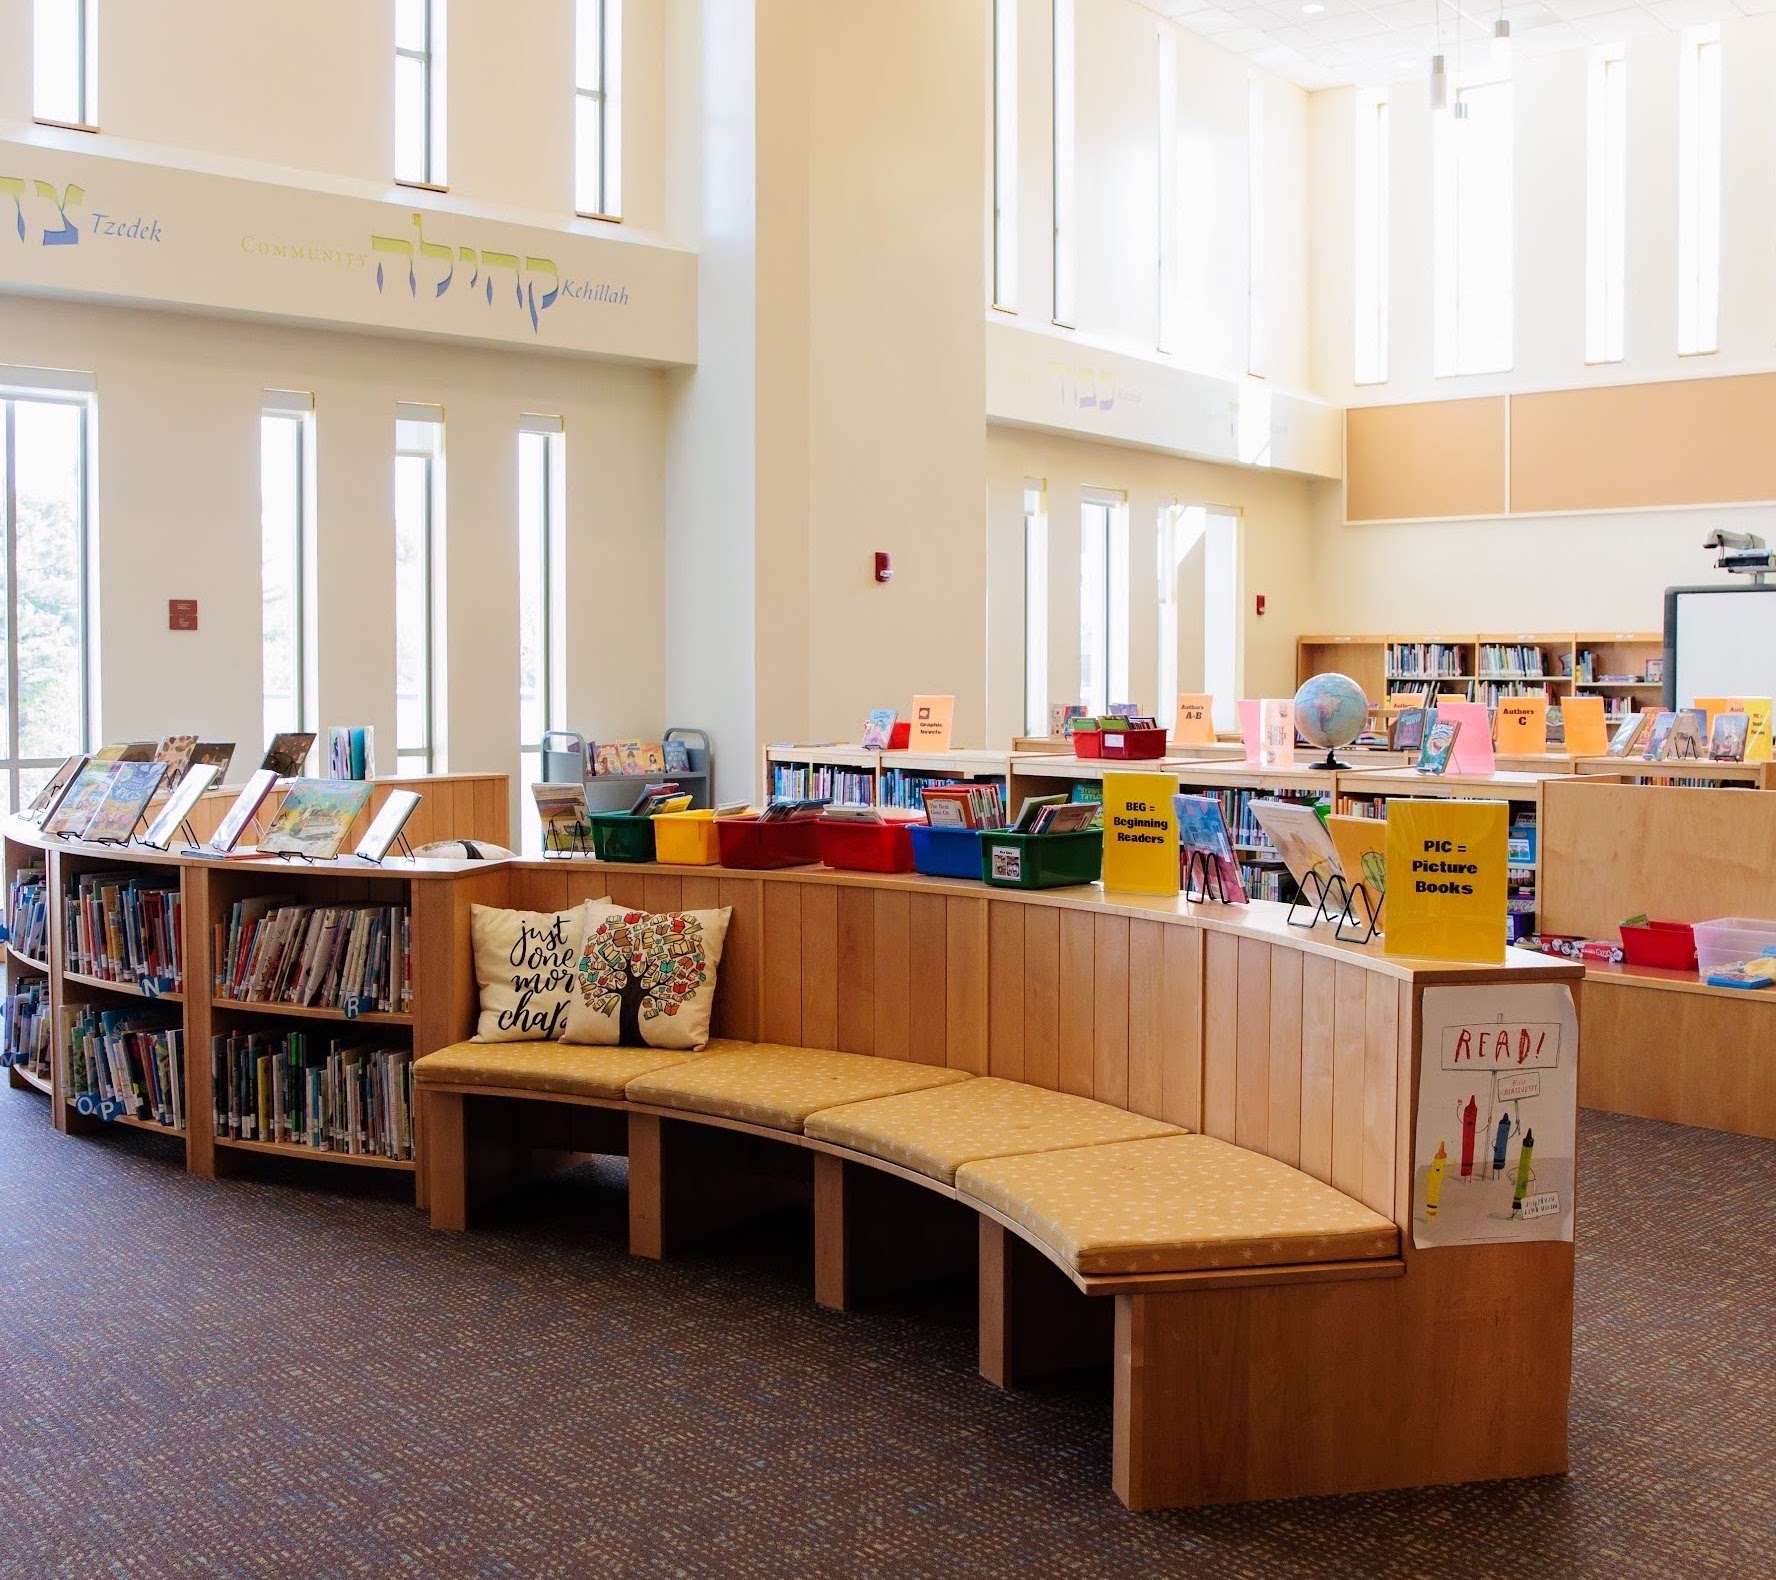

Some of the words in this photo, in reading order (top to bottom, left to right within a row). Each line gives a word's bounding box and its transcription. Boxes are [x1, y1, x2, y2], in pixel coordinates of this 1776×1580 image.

[0, 176, 87, 246] צד
[91, 213, 162, 243] Tzedek
[371, 213, 560, 336] קהילה
[561, 279, 629, 306] Kehillah
[1185, 711, 1203, 720] A-B
[1503, 708, 1535, 716] Authors
[1518, 716, 1528, 727] C
[1125, 801, 1146, 813] BEG
[1113, 816, 1169, 831] Beginning
[1117, 831, 1165, 845] Readers
[1423, 839, 1453, 854] PIC
[1457, 845, 1467, 853] =
[1411, 859, 1478, 875] Picture
[1415, 880, 1474, 895] Books
[509, 915, 571, 967] just
[527, 946, 577, 970] one
[144, 977, 161, 997] N
[511, 967, 576, 995] mor
[347, 996, 360, 1018] R
[498, 990, 571, 1040] chap
[1454, 1027, 1547, 1065] READ!
[0, 1053, 17, 1067] M
[77, 1096, 95, 1116] O
[100, 1100, 115, 1121] P
